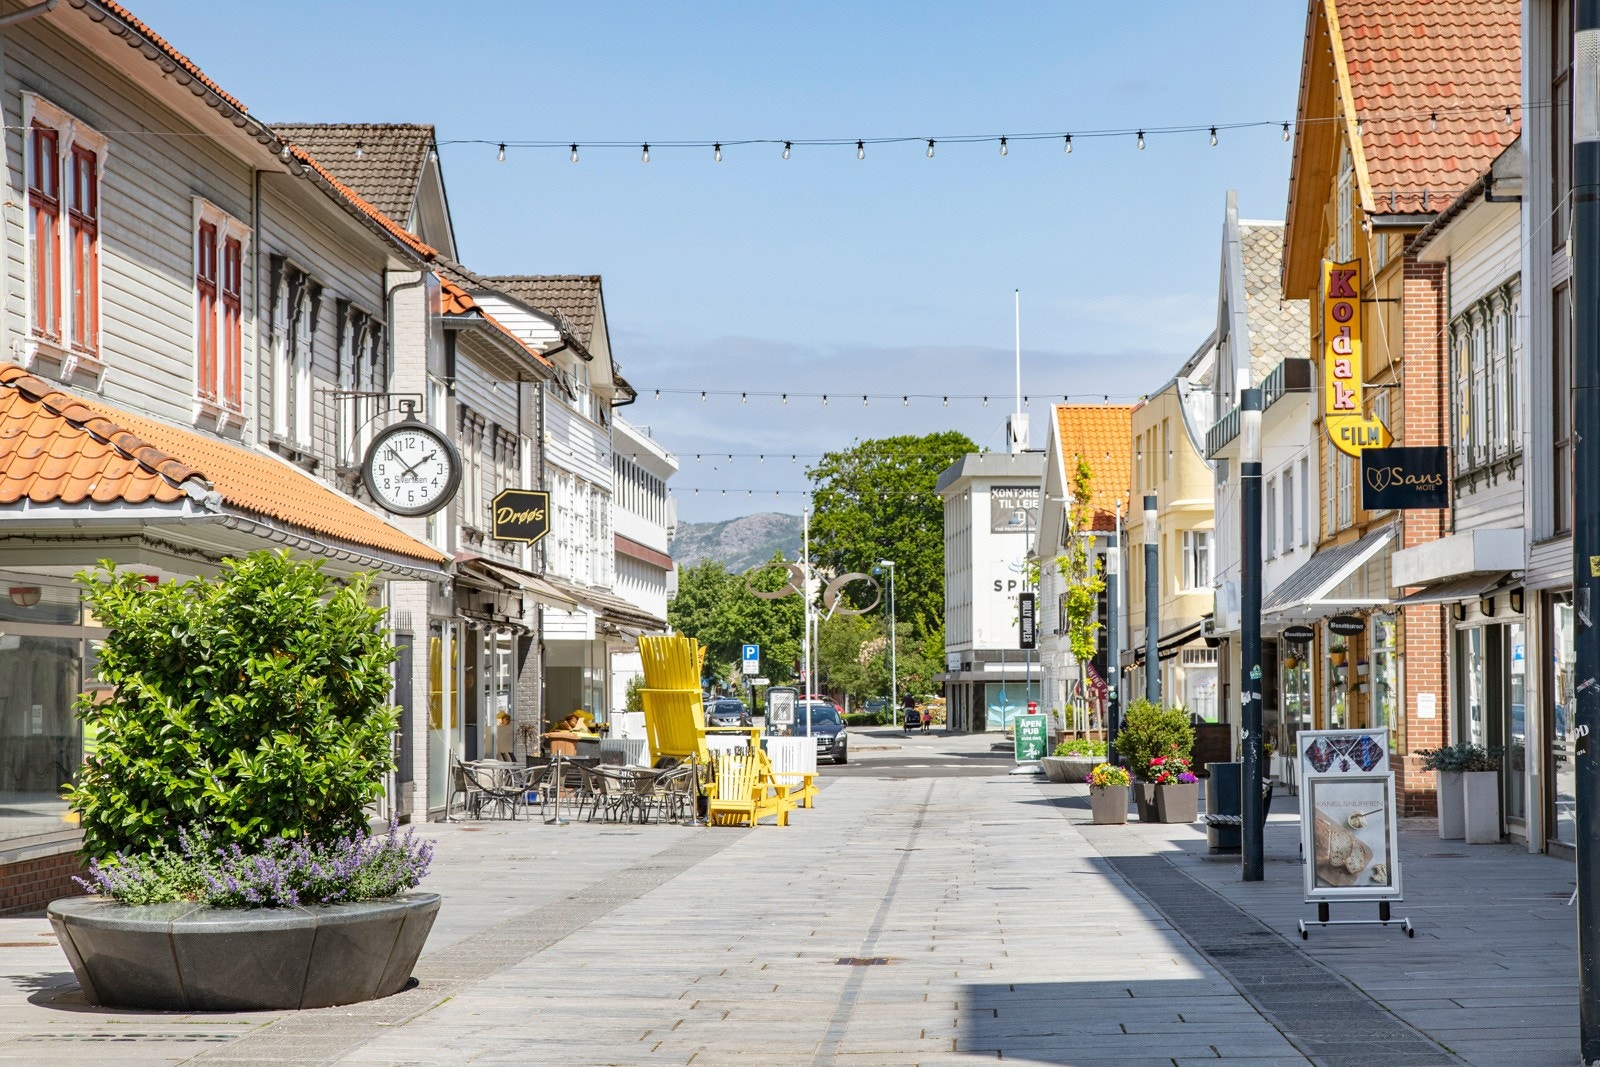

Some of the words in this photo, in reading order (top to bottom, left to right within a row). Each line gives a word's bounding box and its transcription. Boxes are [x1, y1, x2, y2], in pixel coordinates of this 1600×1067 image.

[1329, 270, 1358, 410] Kodak
[394, 440, 402, 452] 11
[405, 437, 415, 449] 12
[421, 440, 425, 452] 1
[384, 450, 394, 461] 10
[430, 449, 437, 461] 2
[378, 464, 385, 476] 9
[436, 463, 443, 474] 3
[1390, 466, 1444, 486] Sans
[384, 478, 391, 490] 8
[431, 477, 439, 488] 4
[394, 486, 401, 498] 7
[408, 490, 414, 502] 6
[421, 486, 428, 498] 5
[998, 500, 1014, 508] TIL
[1016, 500, 1039, 508] LEIE
[497, 508, 544, 524] Drøøs
[746, 646, 756, 659] P
[1020, 718, 1042, 728] ÅPEN
